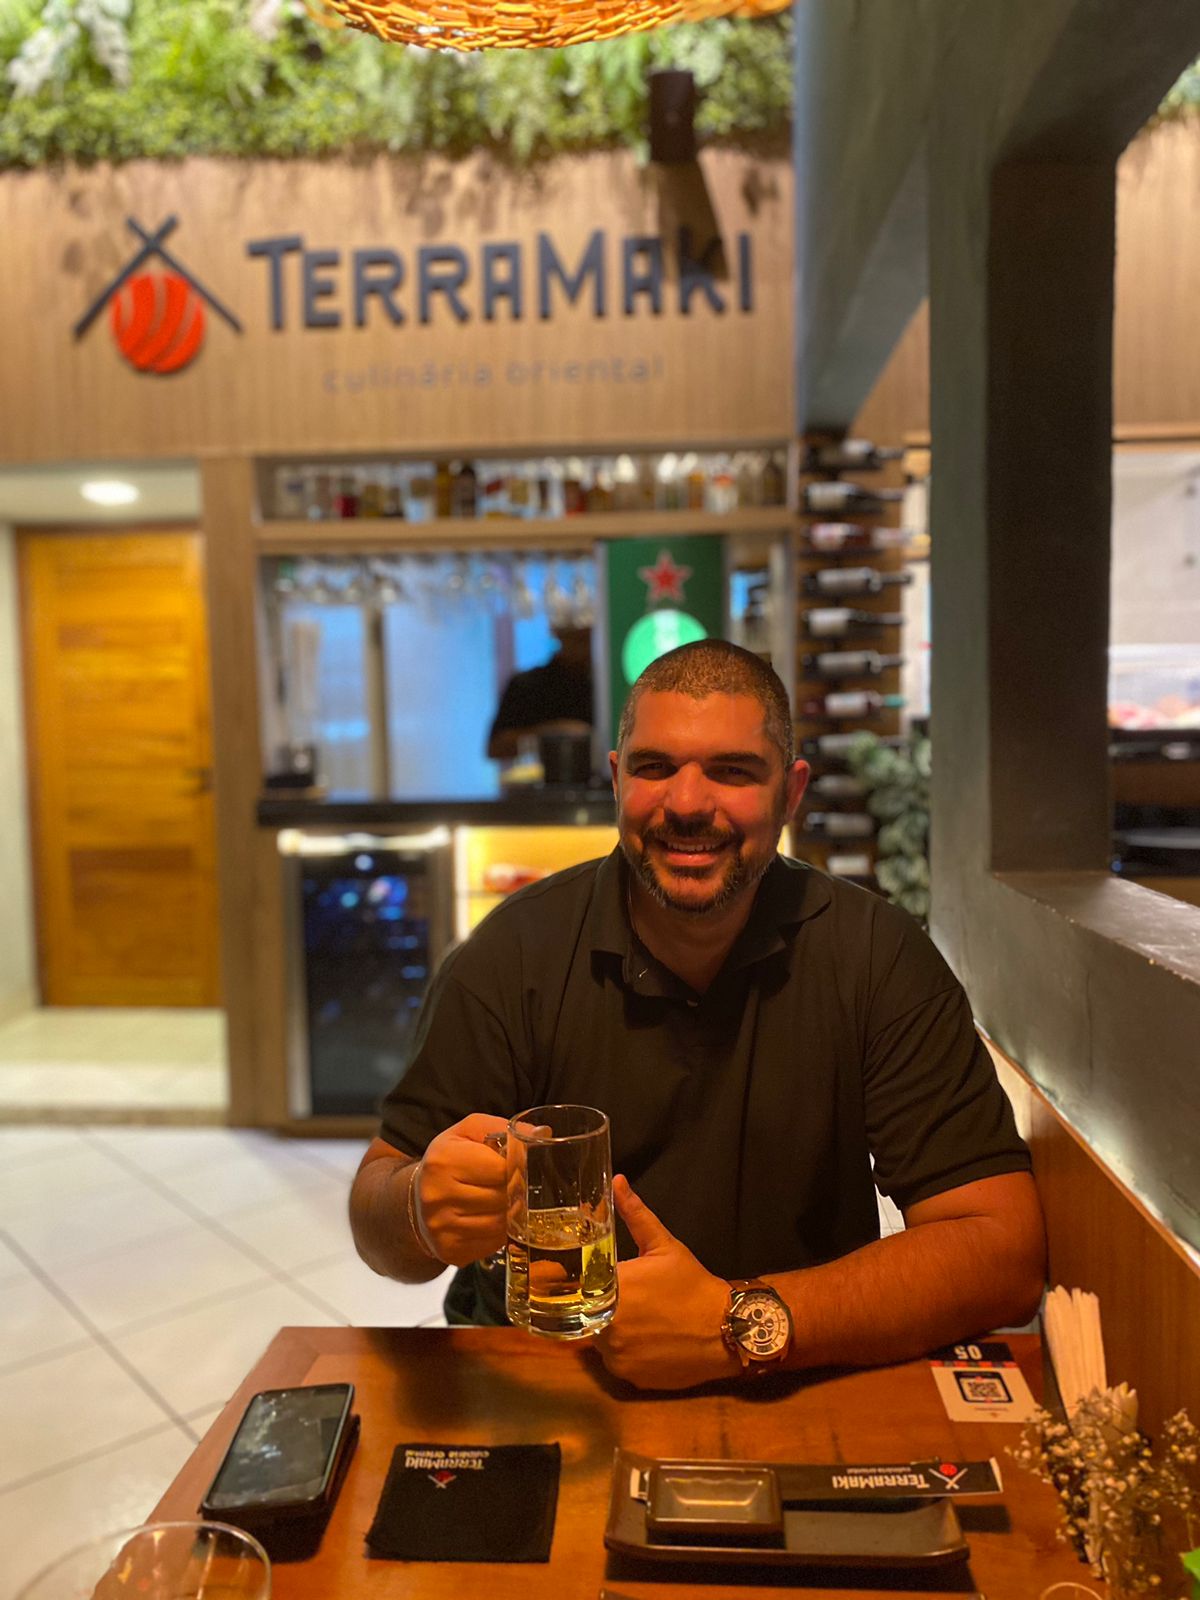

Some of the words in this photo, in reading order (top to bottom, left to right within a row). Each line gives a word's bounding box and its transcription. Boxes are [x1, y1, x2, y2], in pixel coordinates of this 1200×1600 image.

[247, 229, 755, 331] TERRAMAKI
[505, 354, 665, 387] oriental
[954, 1345, 982, 1360] 05
[832, 1473, 931, 1490] TERRAMAKI
